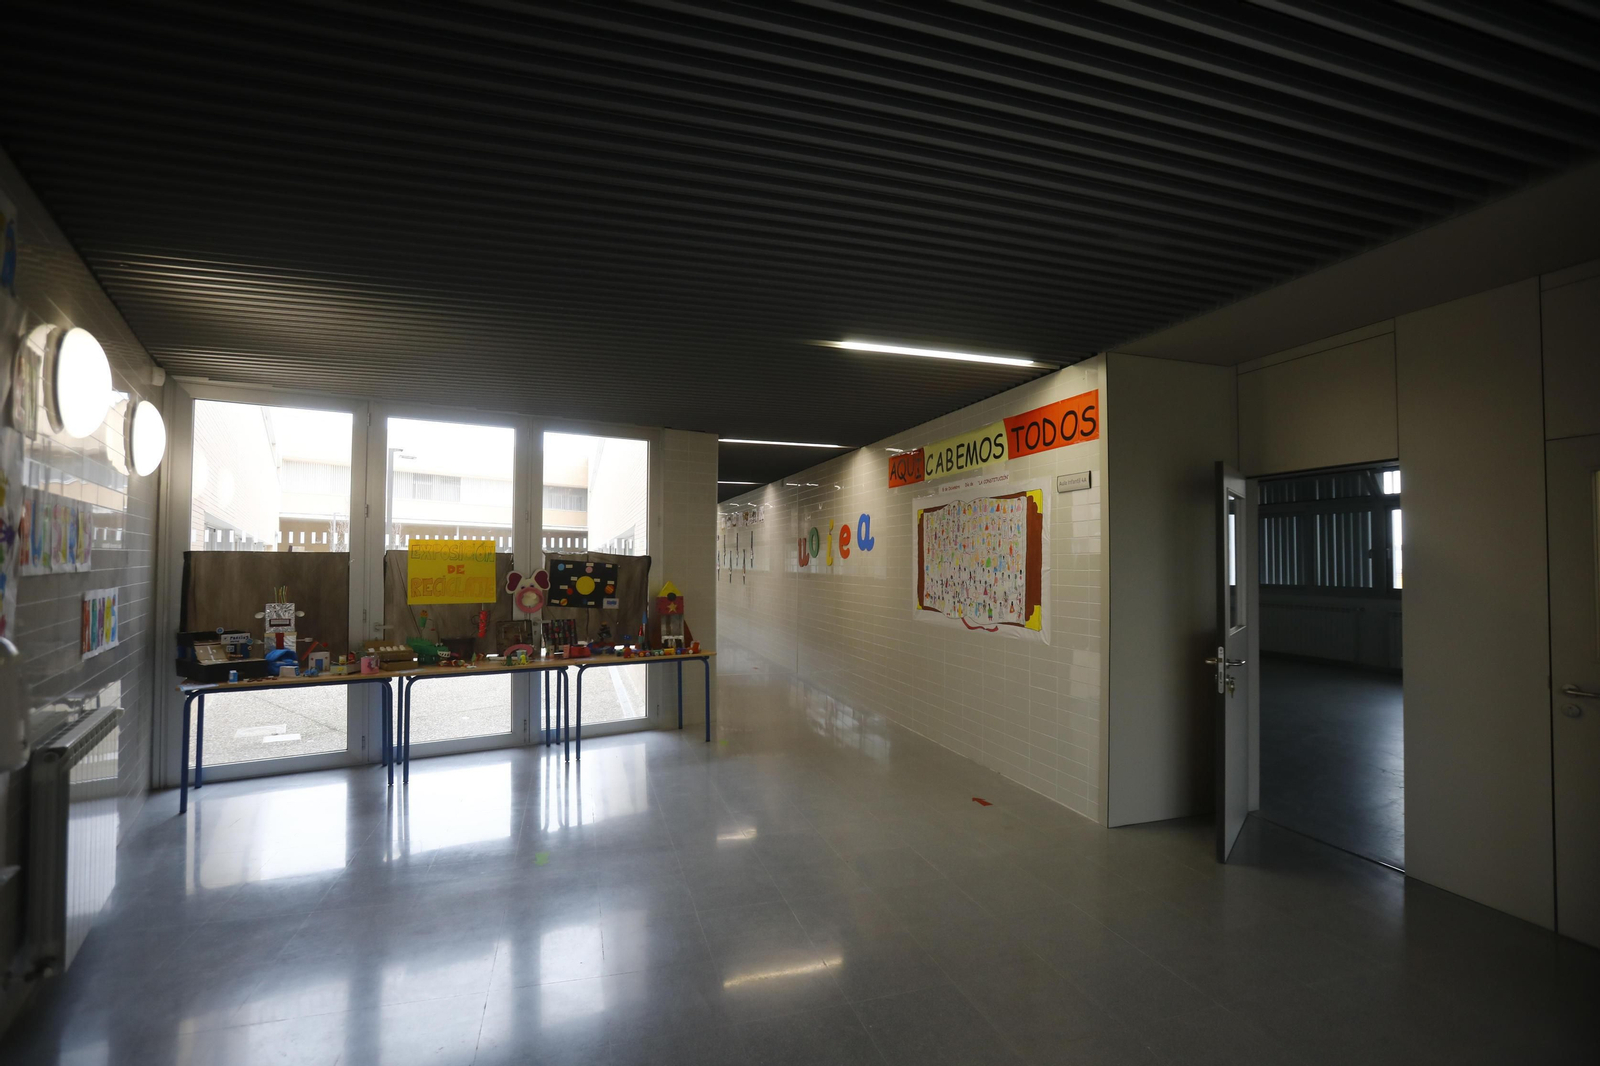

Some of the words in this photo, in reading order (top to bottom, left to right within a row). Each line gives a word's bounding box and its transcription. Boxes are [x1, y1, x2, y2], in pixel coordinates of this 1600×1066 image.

[926, 433, 1005, 476] CABEMOS
[1011, 405, 1097, 453] TODOS
[411, 541, 495, 563] EXPOSICIÓN
[447, 564, 465, 574] DE
[411, 575, 495, 598] RECICLAJE
